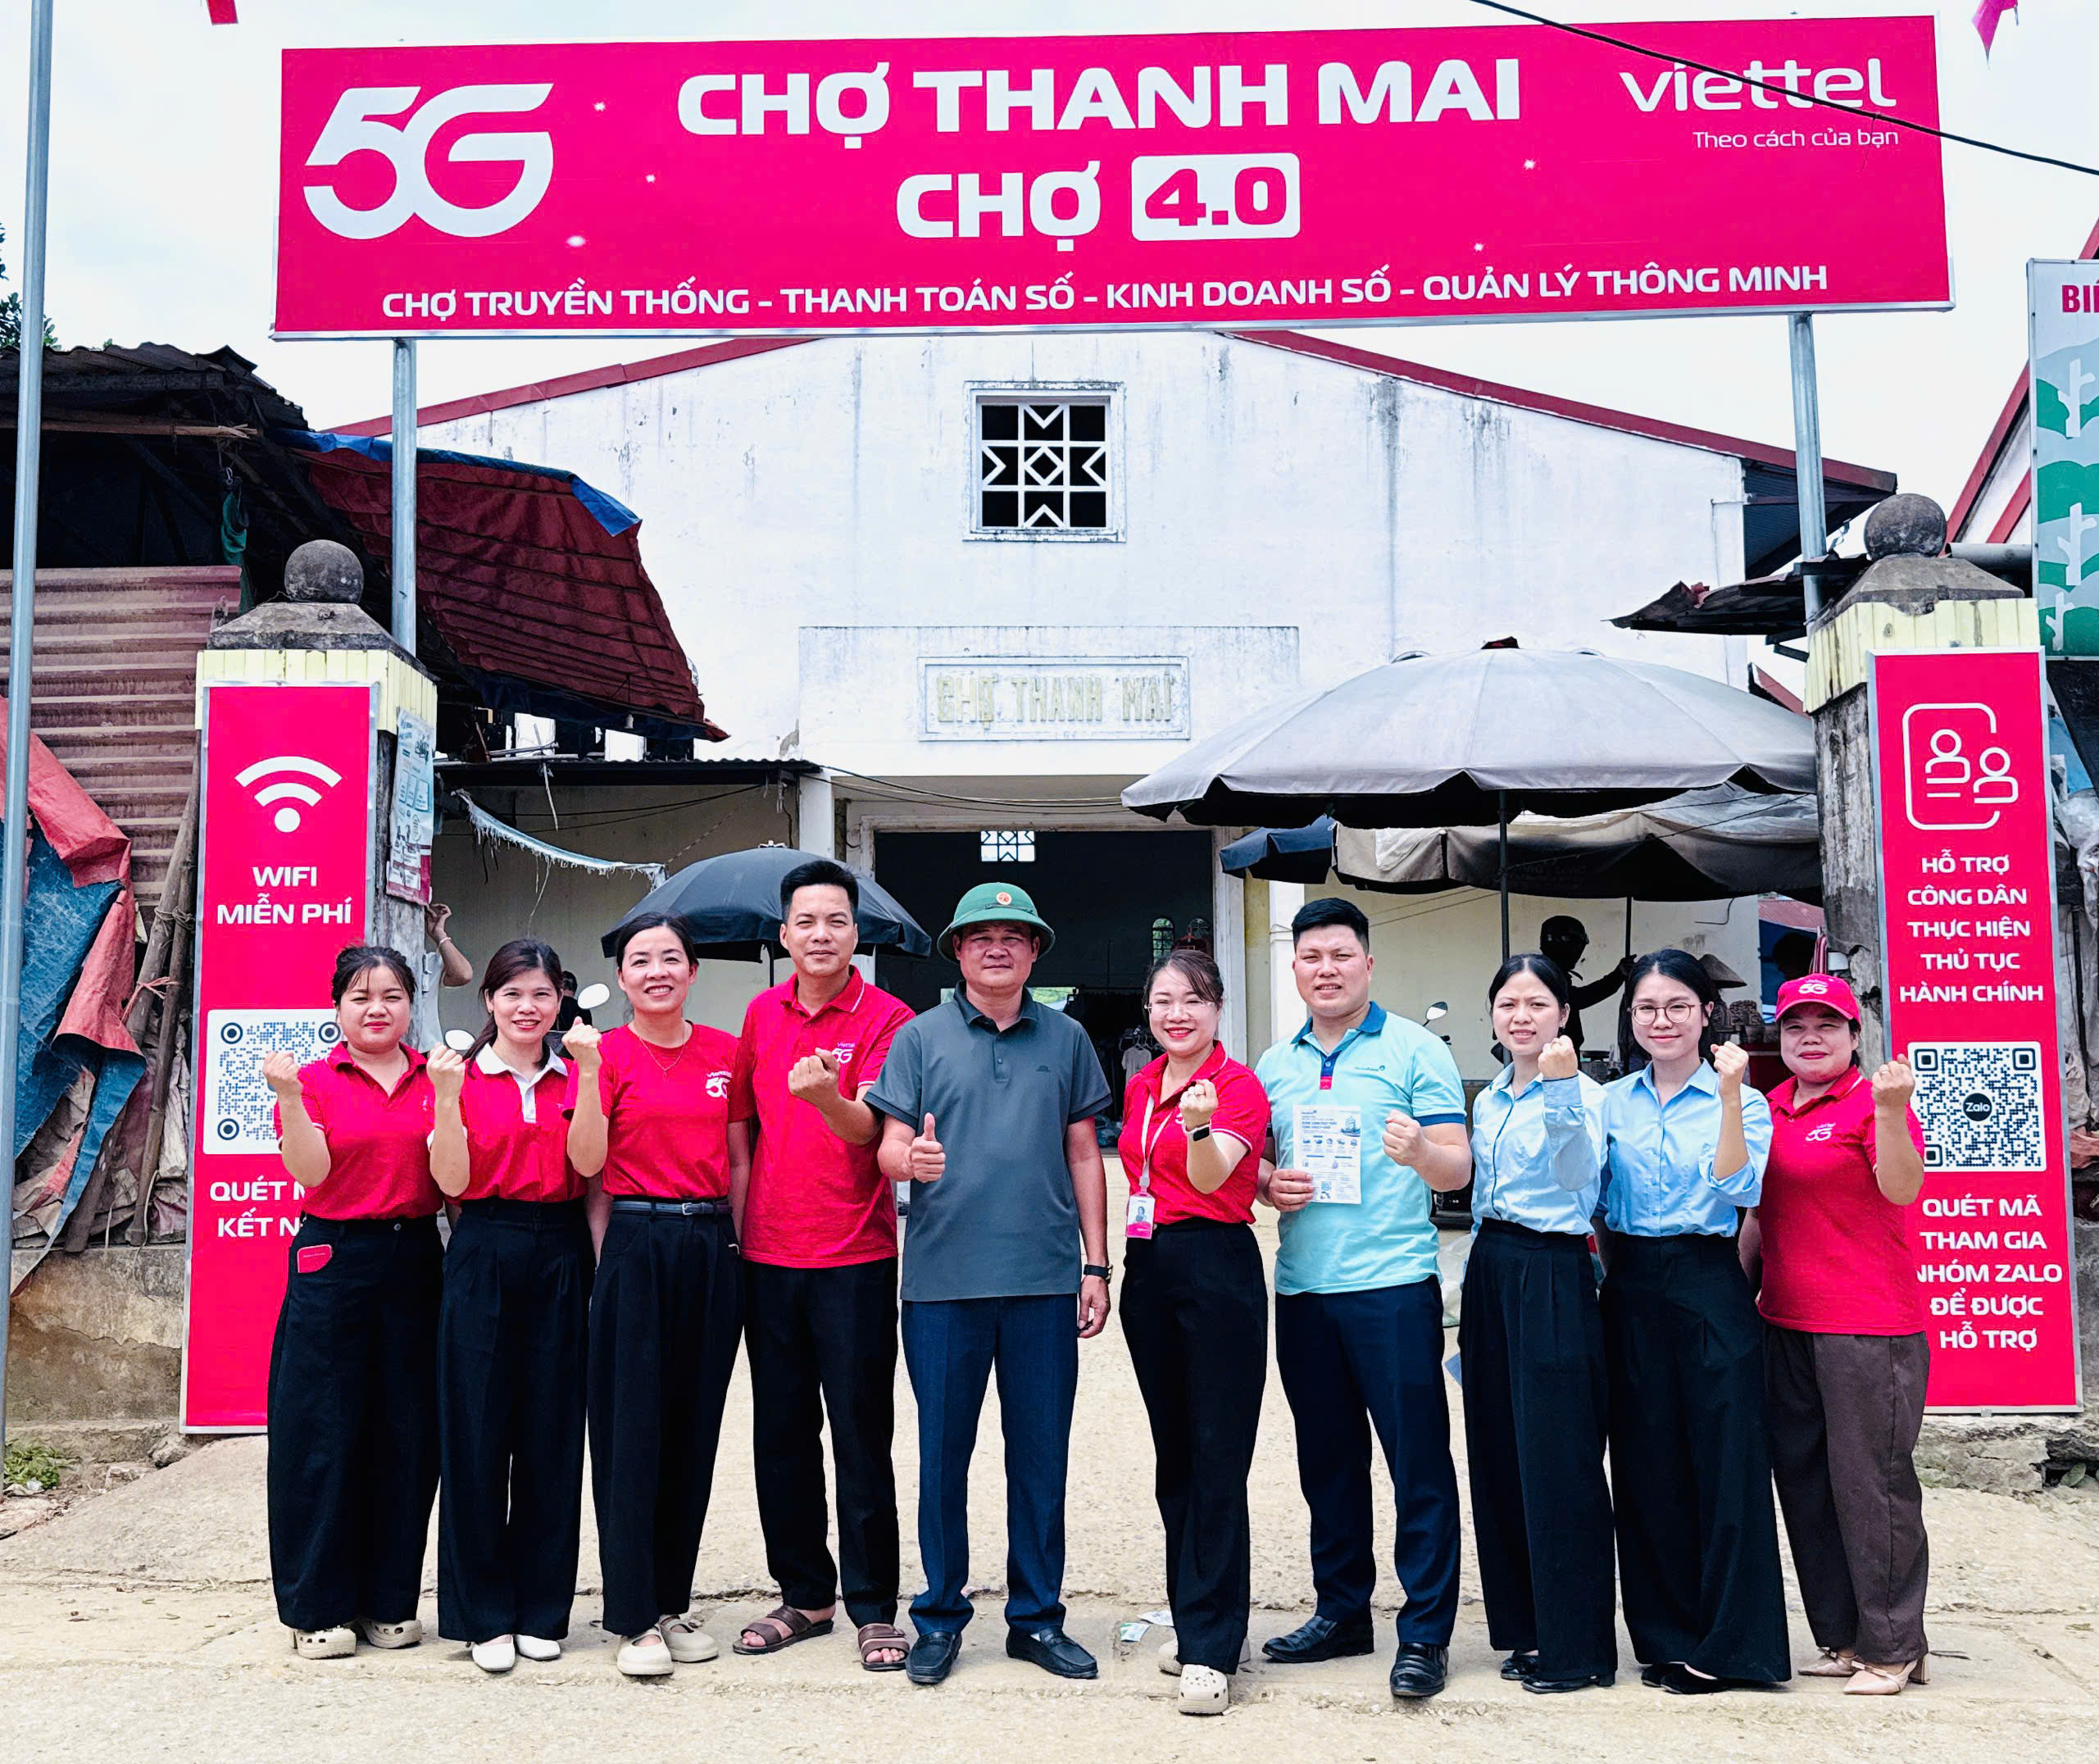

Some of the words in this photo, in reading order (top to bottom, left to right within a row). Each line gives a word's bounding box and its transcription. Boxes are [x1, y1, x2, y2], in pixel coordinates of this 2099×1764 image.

[1619, 58, 1897, 112] viettel
[677, 61, 890, 149] CHỢ
[912, 64, 1288, 133] THANH
[1318, 58, 1520, 125] MAI
[1692, 131, 1747, 148] Theo
[1753, 130, 1805, 148] cách
[1811, 128, 1851, 146] của
[1857, 130, 1898, 148] bạn
[304, 83, 553, 239] 5G
[896, 160, 1101, 252] CHỢ
[1145, 166, 1287, 226] 4.0
[382, 289, 457, 322] CHỢ
[464, 277, 612, 316] TRUYỀN
[620, 275, 749, 315] THỐNG
[779, 287, 907, 313] THANH
[915, 278, 1016, 311] TOÁN
[1025, 271, 1074, 310] SỐ
[1106, 282, 1193, 309] KINH
[1202, 279, 1332, 307] DOANH
[1341, 264, 1392, 303] SỐ
[1423, 266, 1529, 301] QUẢN
[1539, 263, 1581, 298] LÝ
[1587, 261, 1720, 295] THÔNG
[1729, 266, 1827, 292] MINH
[1921, 848, 1956, 873] HỖ
[1960, 854, 2010, 875] TRỢ
[252, 866, 317, 887] WIFI
[1907, 884, 1973, 906] CÔNG
[1977, 884, 2027, 905] DÂN
[217, 893, 295, 925] MIỄN
[302, 896, 352, 924] PHÍ
[1906, 918, 1971, 940] THỰC
[1975, 916, 2031, 939] HIỆN
[1920, 948, 1969, 970] THỦ
[1973, 952, 2020, 972] TỤC
[1900, 980, 1967, 1002] HÀNH
[1972, 980, 2043, 1002] CHÍNH
[1965, 1102, 1991, 1112] Zalo
[210, 1175, 288, 1202] QUÉT
[1922, 1193, 1994, 1217] QUÉT
[1999, 1194, 2042, 1216] MÃ
[218, 1207, 274, 1238] KẾT
[1919, 1231, 1998, 1250] THAM
[2003, 1231, 2047, 1249] GIA
[1916, 1258, 1990, 1283] NHÓM
[1995, 1264, 2063, 1283] ZALO
[1929, 1287, 1966, 1316] ĐỂ
[1970, 1294, 2044, 1319] ĐƯỢC
[1939, 1321, 1978, 1349] HỖ
[1982, 1328, 2038, 1352] TRỢ
